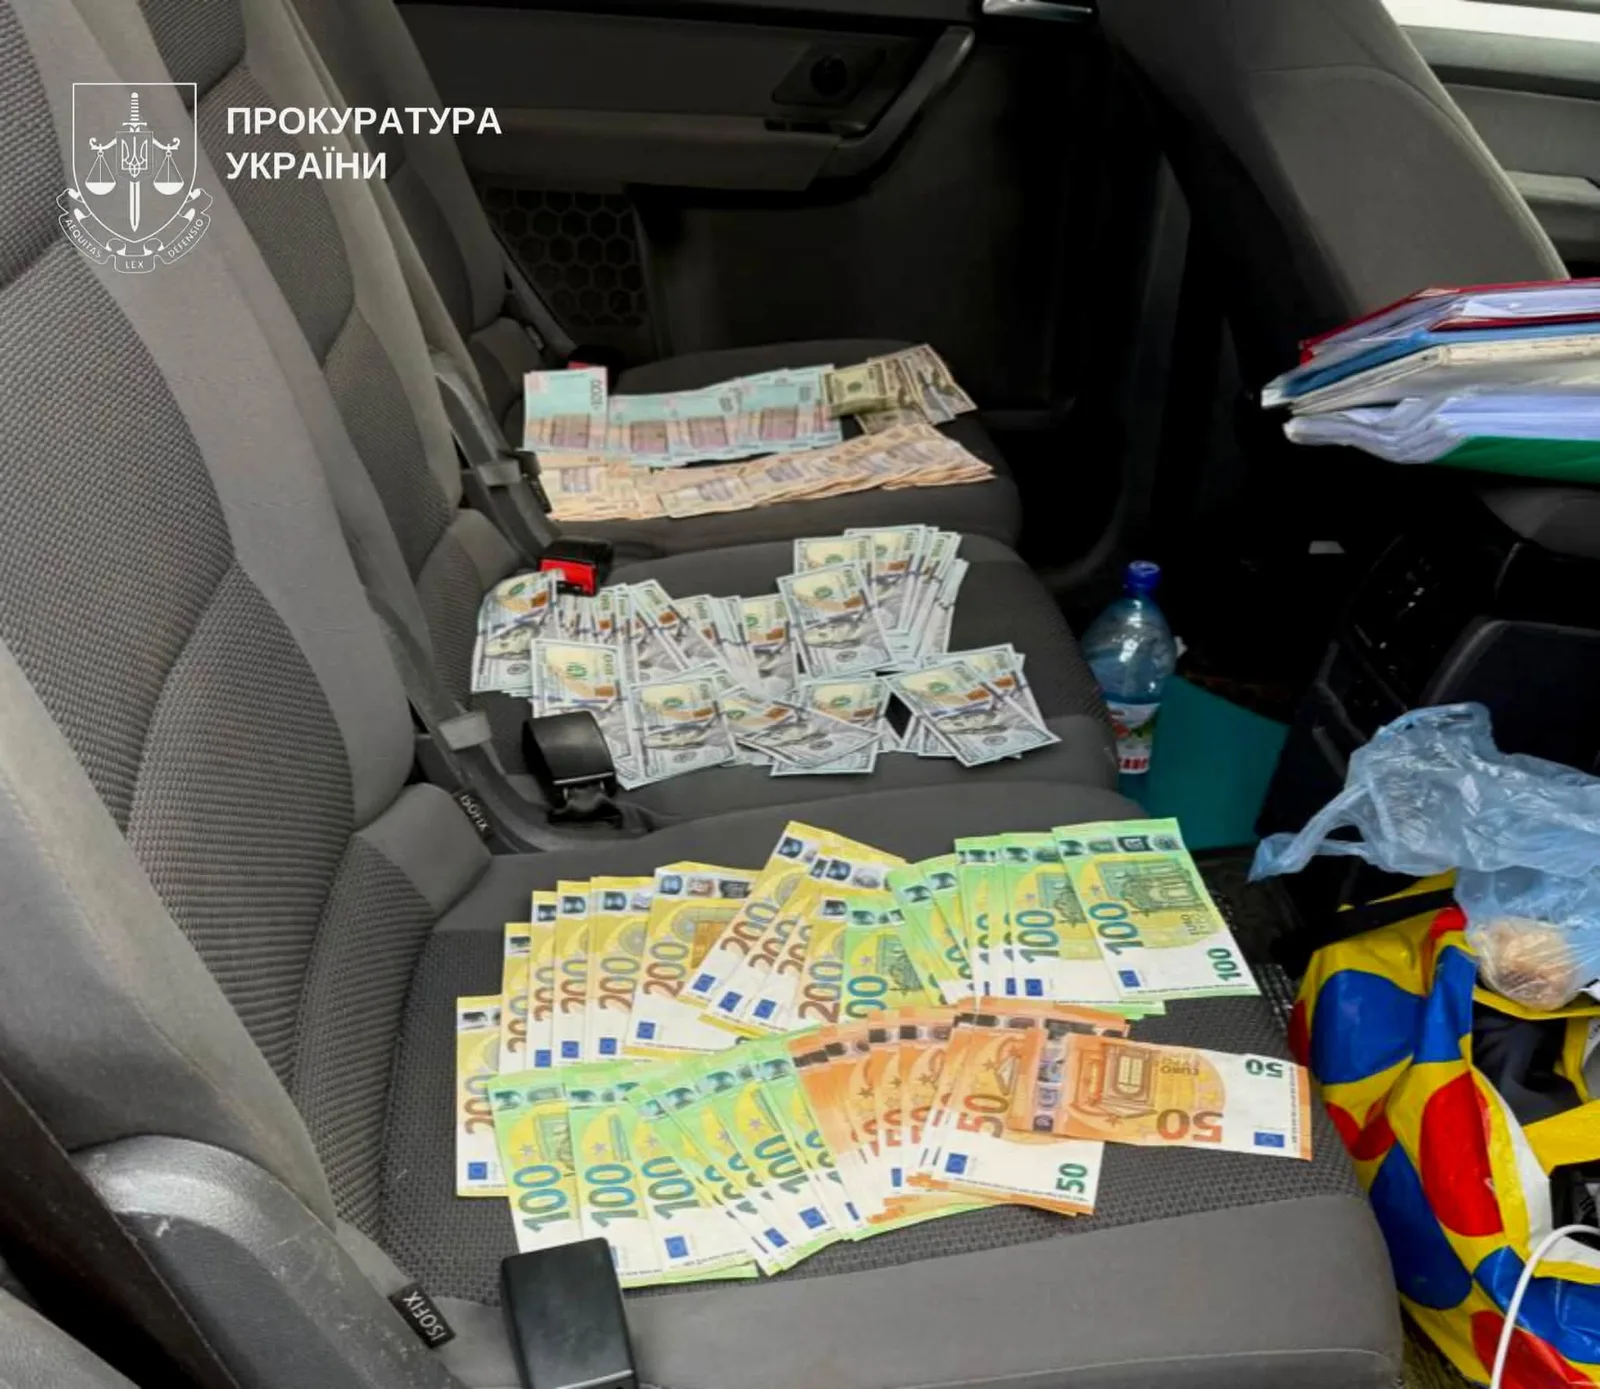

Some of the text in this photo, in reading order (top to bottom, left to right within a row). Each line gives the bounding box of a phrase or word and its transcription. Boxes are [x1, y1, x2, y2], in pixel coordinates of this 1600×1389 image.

[720, 902, 779, 955] 200
[1014, 909, 1061, 964] 100
[1088, 902, 1145, 957] 100
[643, 941, 690, 998] 200
[1206, 947, 1242, 981] 100
[800, 960, 844, 1024] 200
[1245, 1058, 1283, 1079] 50
[955, 1093, 1009, 1139] 50
[1156, 1108, 1224, 1143] 50
[512, 1163, 572, 1233] 100
[584, 1163, 639, 1229] 100
[640, 1155, 701, 1221] 100
[1055, 1162, 1089, 1194] 50
[402, 1290, 447, 1341] ISOFIX
